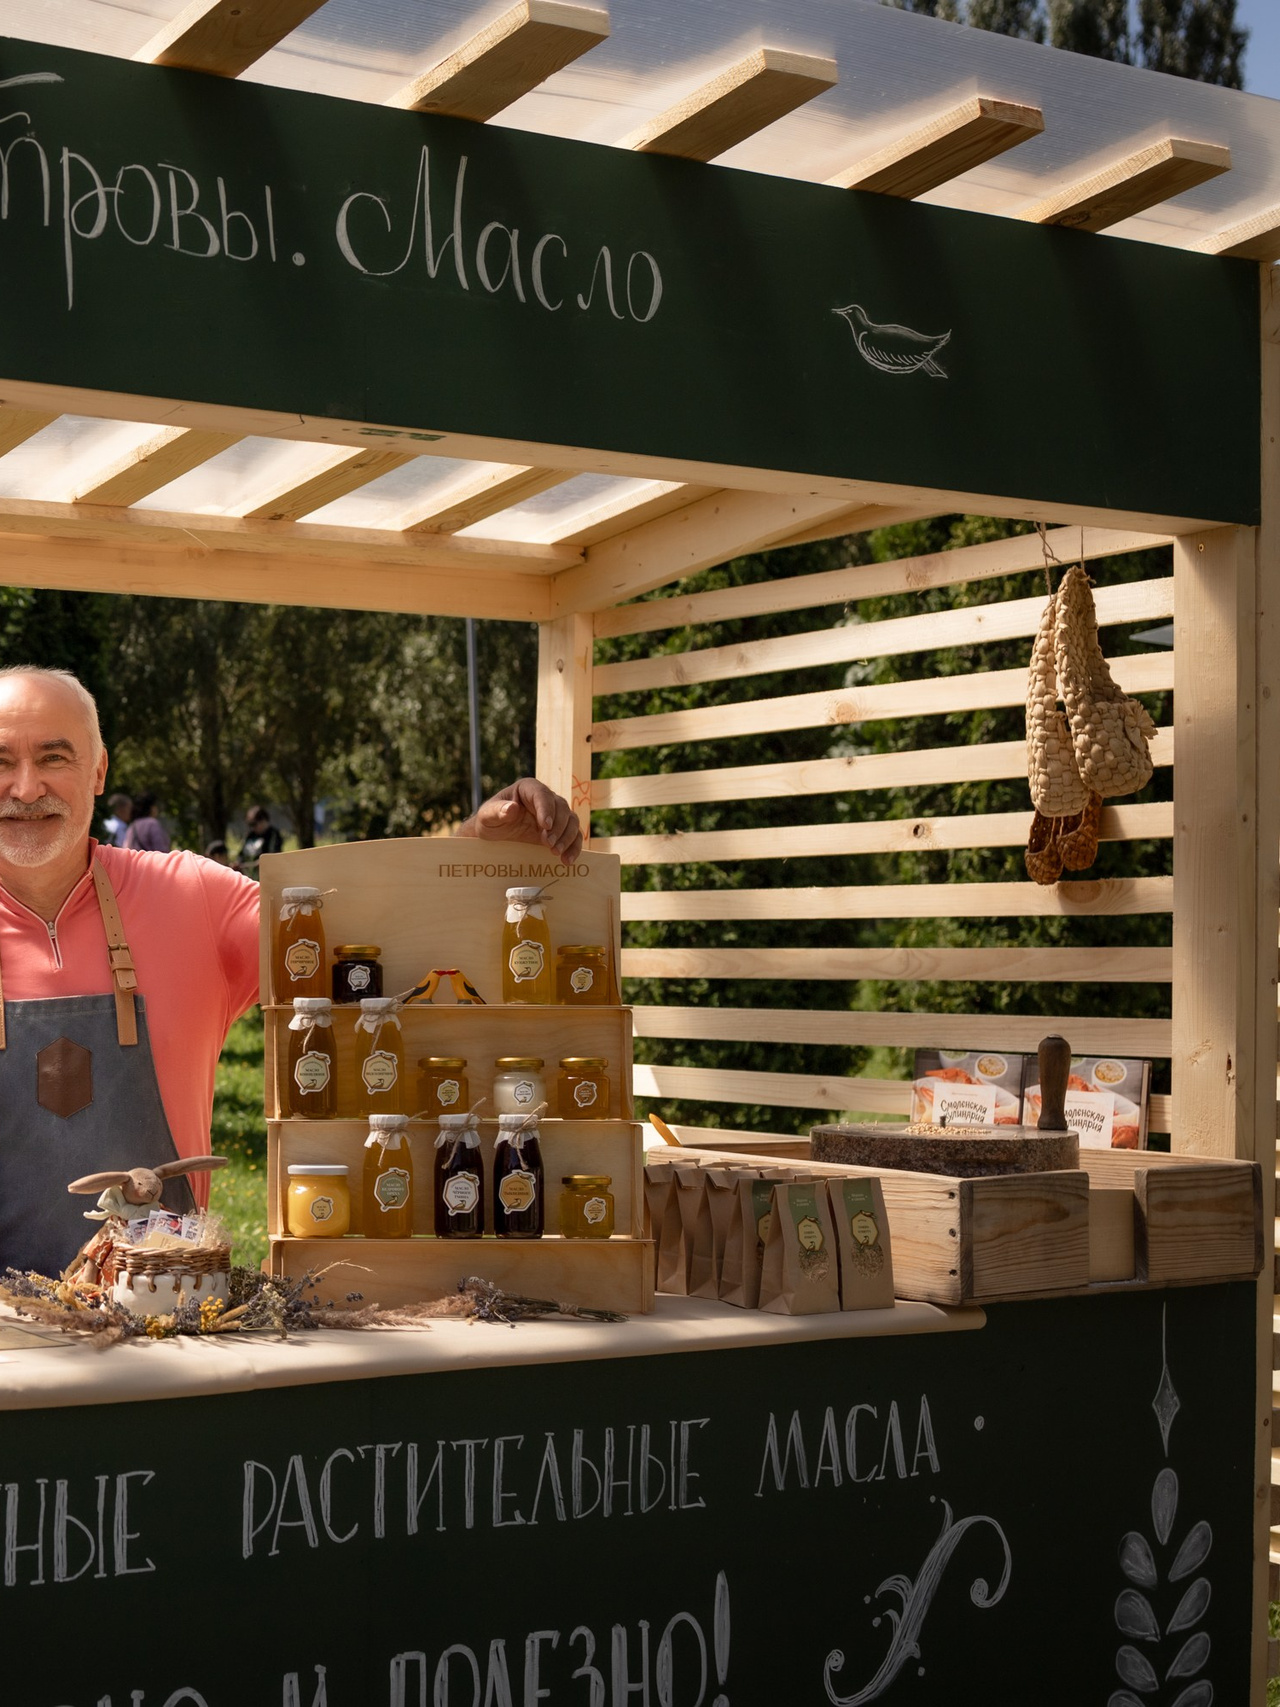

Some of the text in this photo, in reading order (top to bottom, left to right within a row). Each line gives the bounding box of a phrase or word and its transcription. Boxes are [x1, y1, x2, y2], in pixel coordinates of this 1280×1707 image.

[335, 145, 663, 323] Масло
[438, 864, 590, 878] ПЕТРОВЫ.МАСЛО
[242, 1417, 710, 1559] РАСТИТЕЛЬНЫЕ
[754, 1394, 941, 1498] МАСЛА
